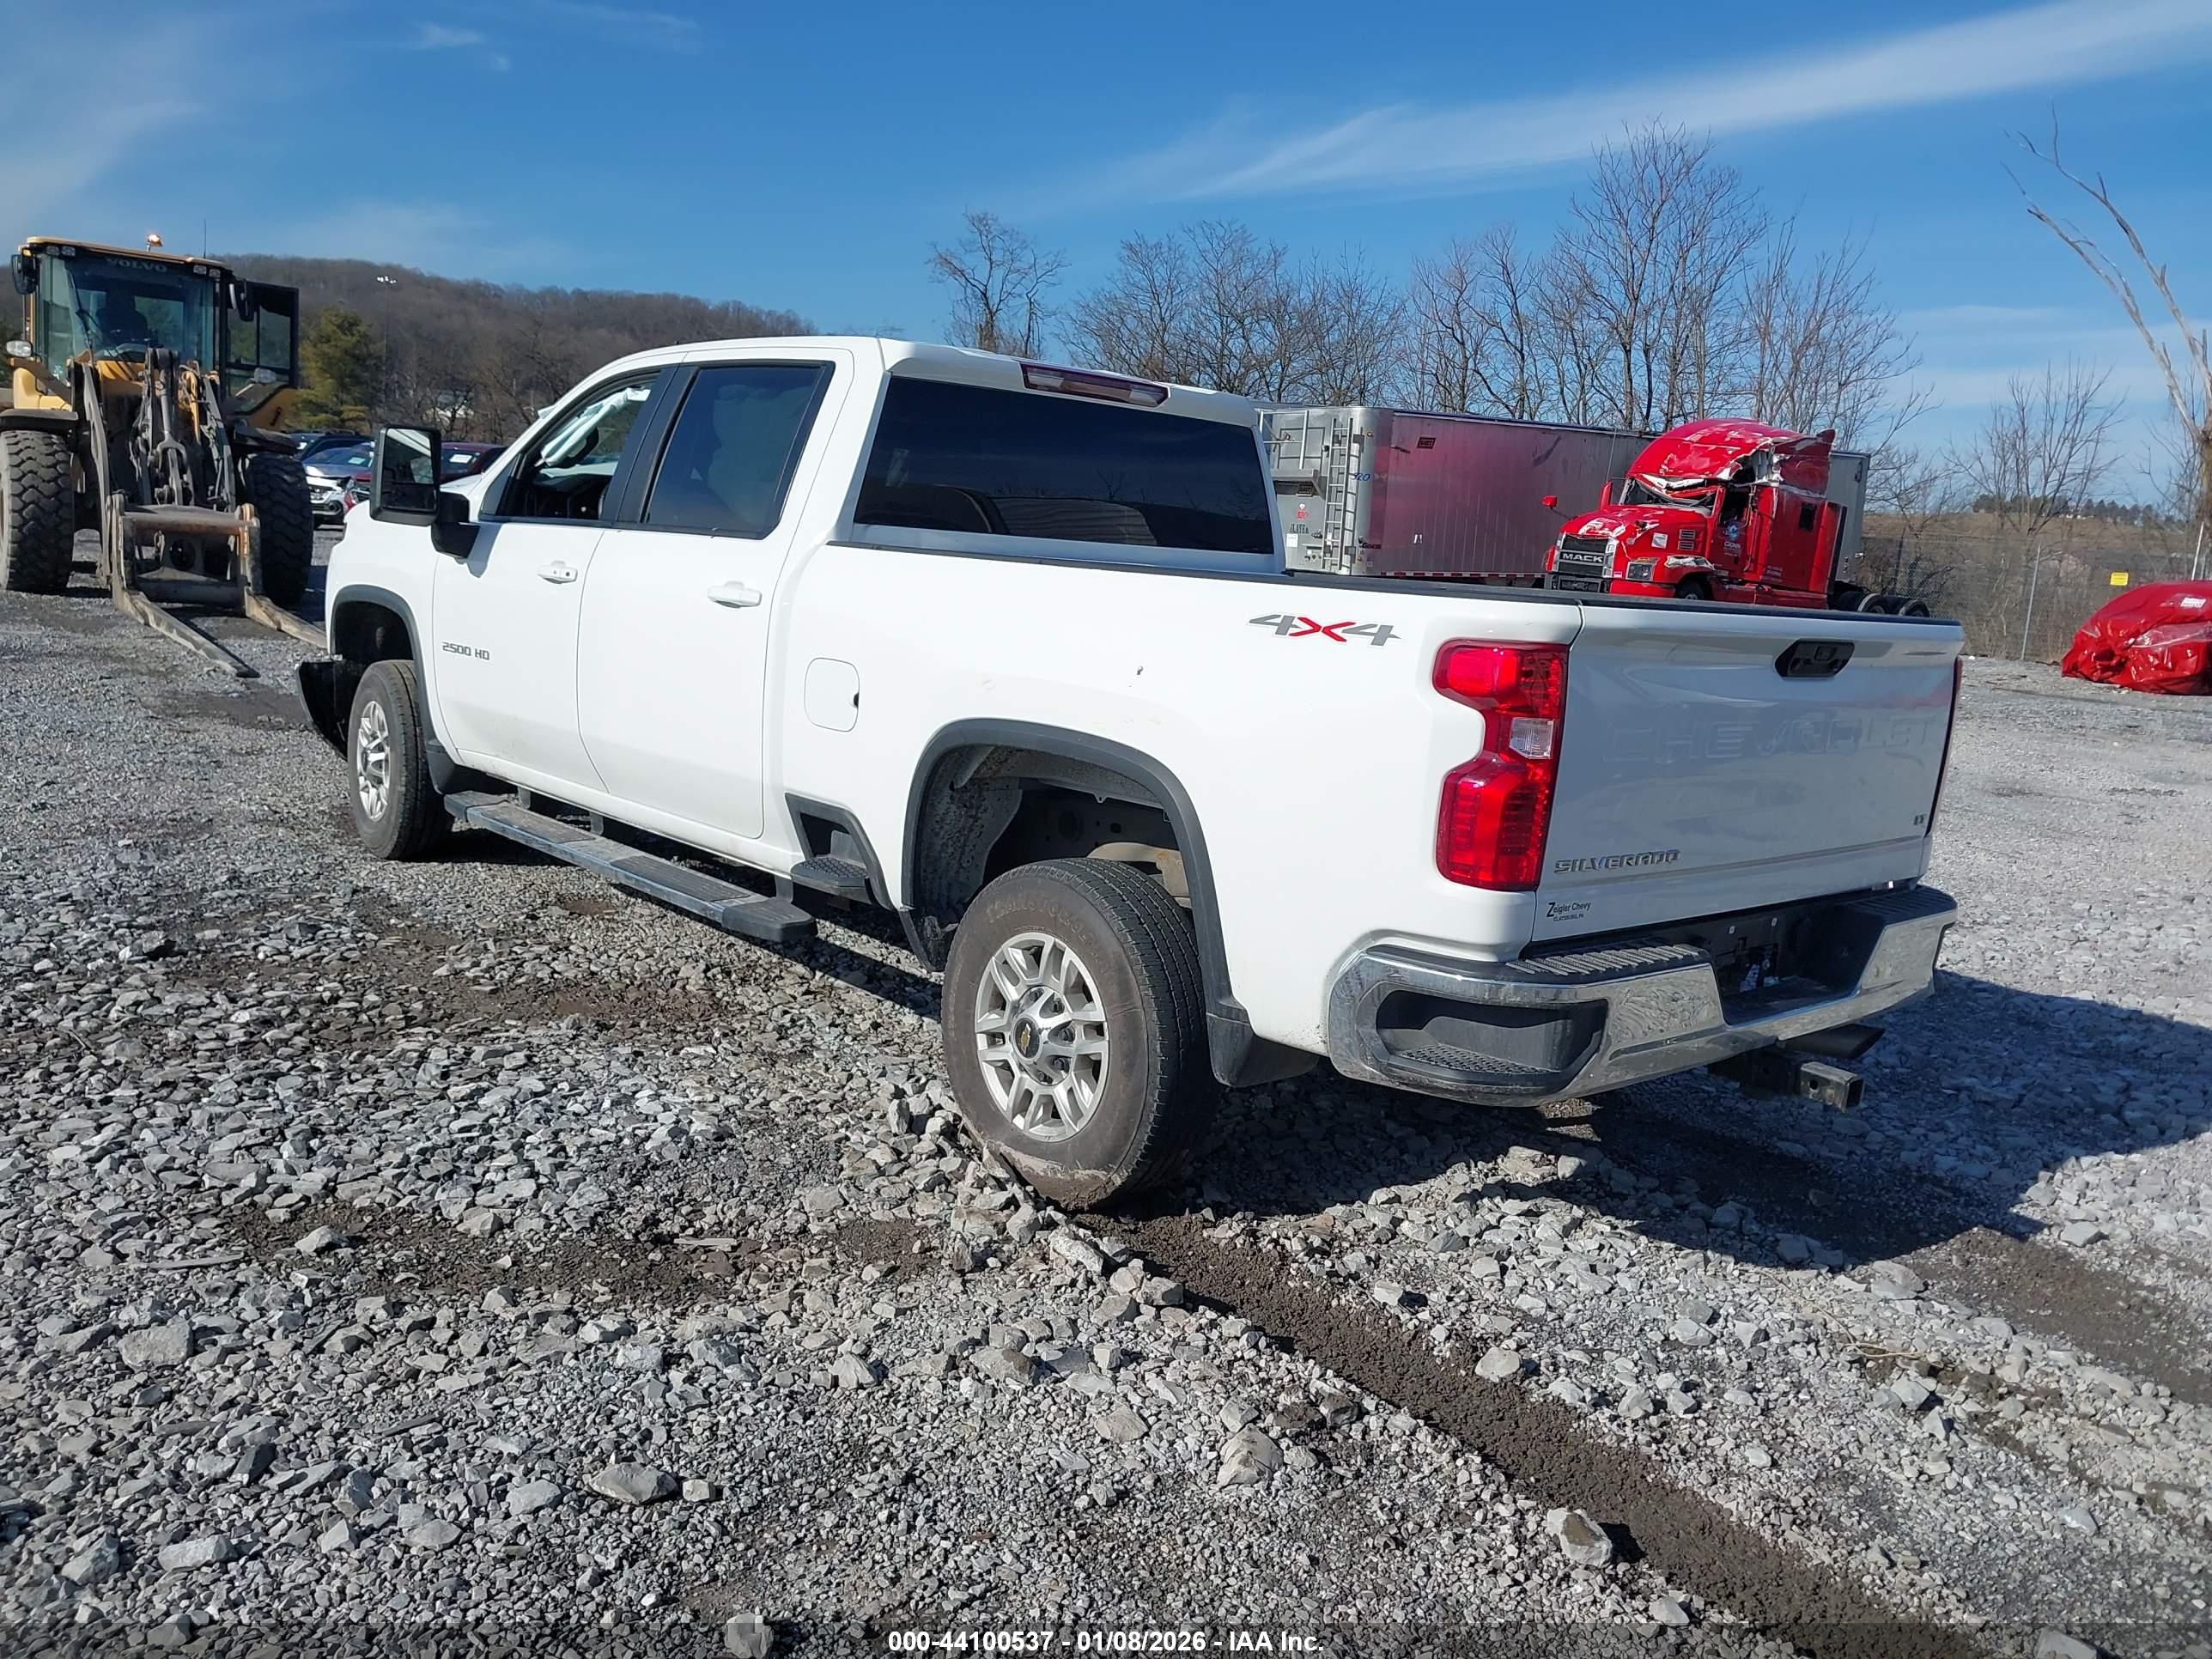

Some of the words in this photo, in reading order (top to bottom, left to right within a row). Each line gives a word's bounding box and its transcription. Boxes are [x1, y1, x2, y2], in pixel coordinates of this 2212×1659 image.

[105, 257, 167, 272] VOLVO
[1563, 552, 1603, 563] MACK
[441, 641, 472, 656] 2500
[474, 647, 490, 660] HD
[1553, 849, 1680, 873] SILVERADO
[1547, 902, 1571, 918] Zeigler
[1571, 902, 1591, 912] Chevy
